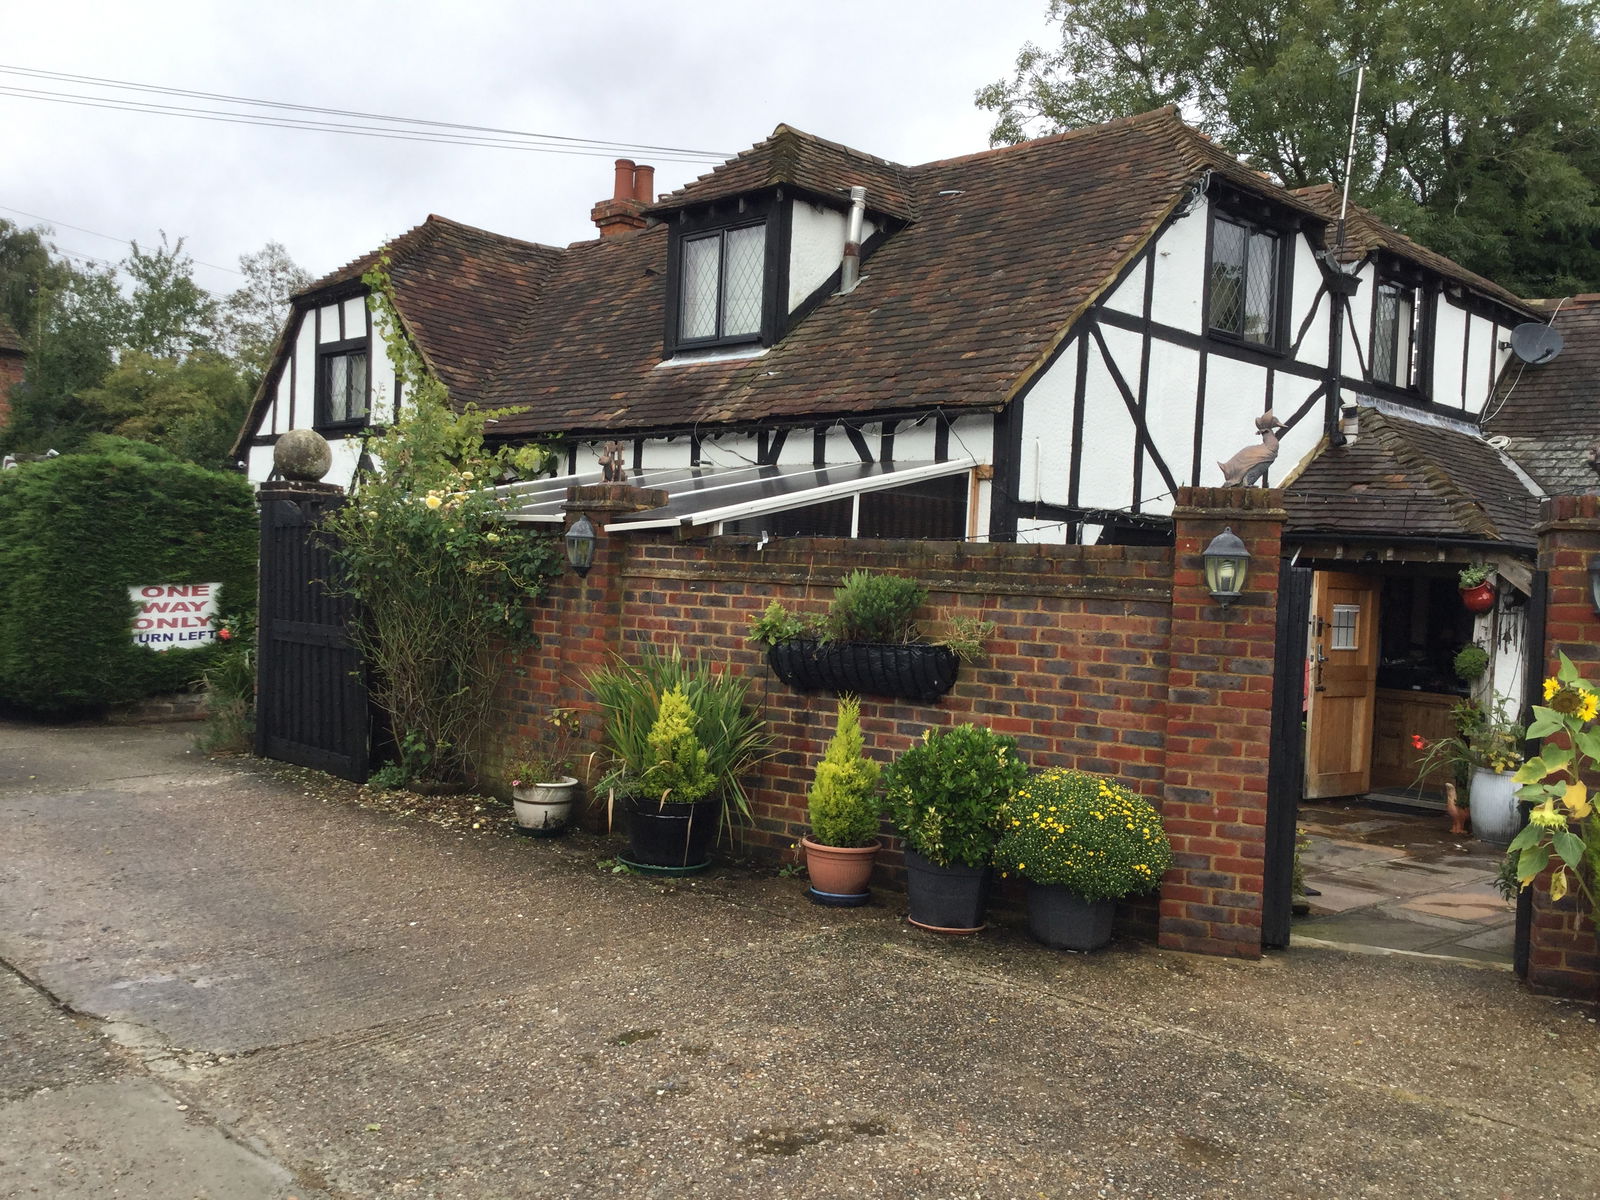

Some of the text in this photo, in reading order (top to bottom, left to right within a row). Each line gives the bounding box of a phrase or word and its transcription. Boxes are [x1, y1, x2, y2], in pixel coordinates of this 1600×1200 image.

[141, 585, 210, 598] ONE
[138, 600, 209, 614] WAY
[132, 615, 213, 630] ONLY
[132, 630, 217, 643] URN LEFT
